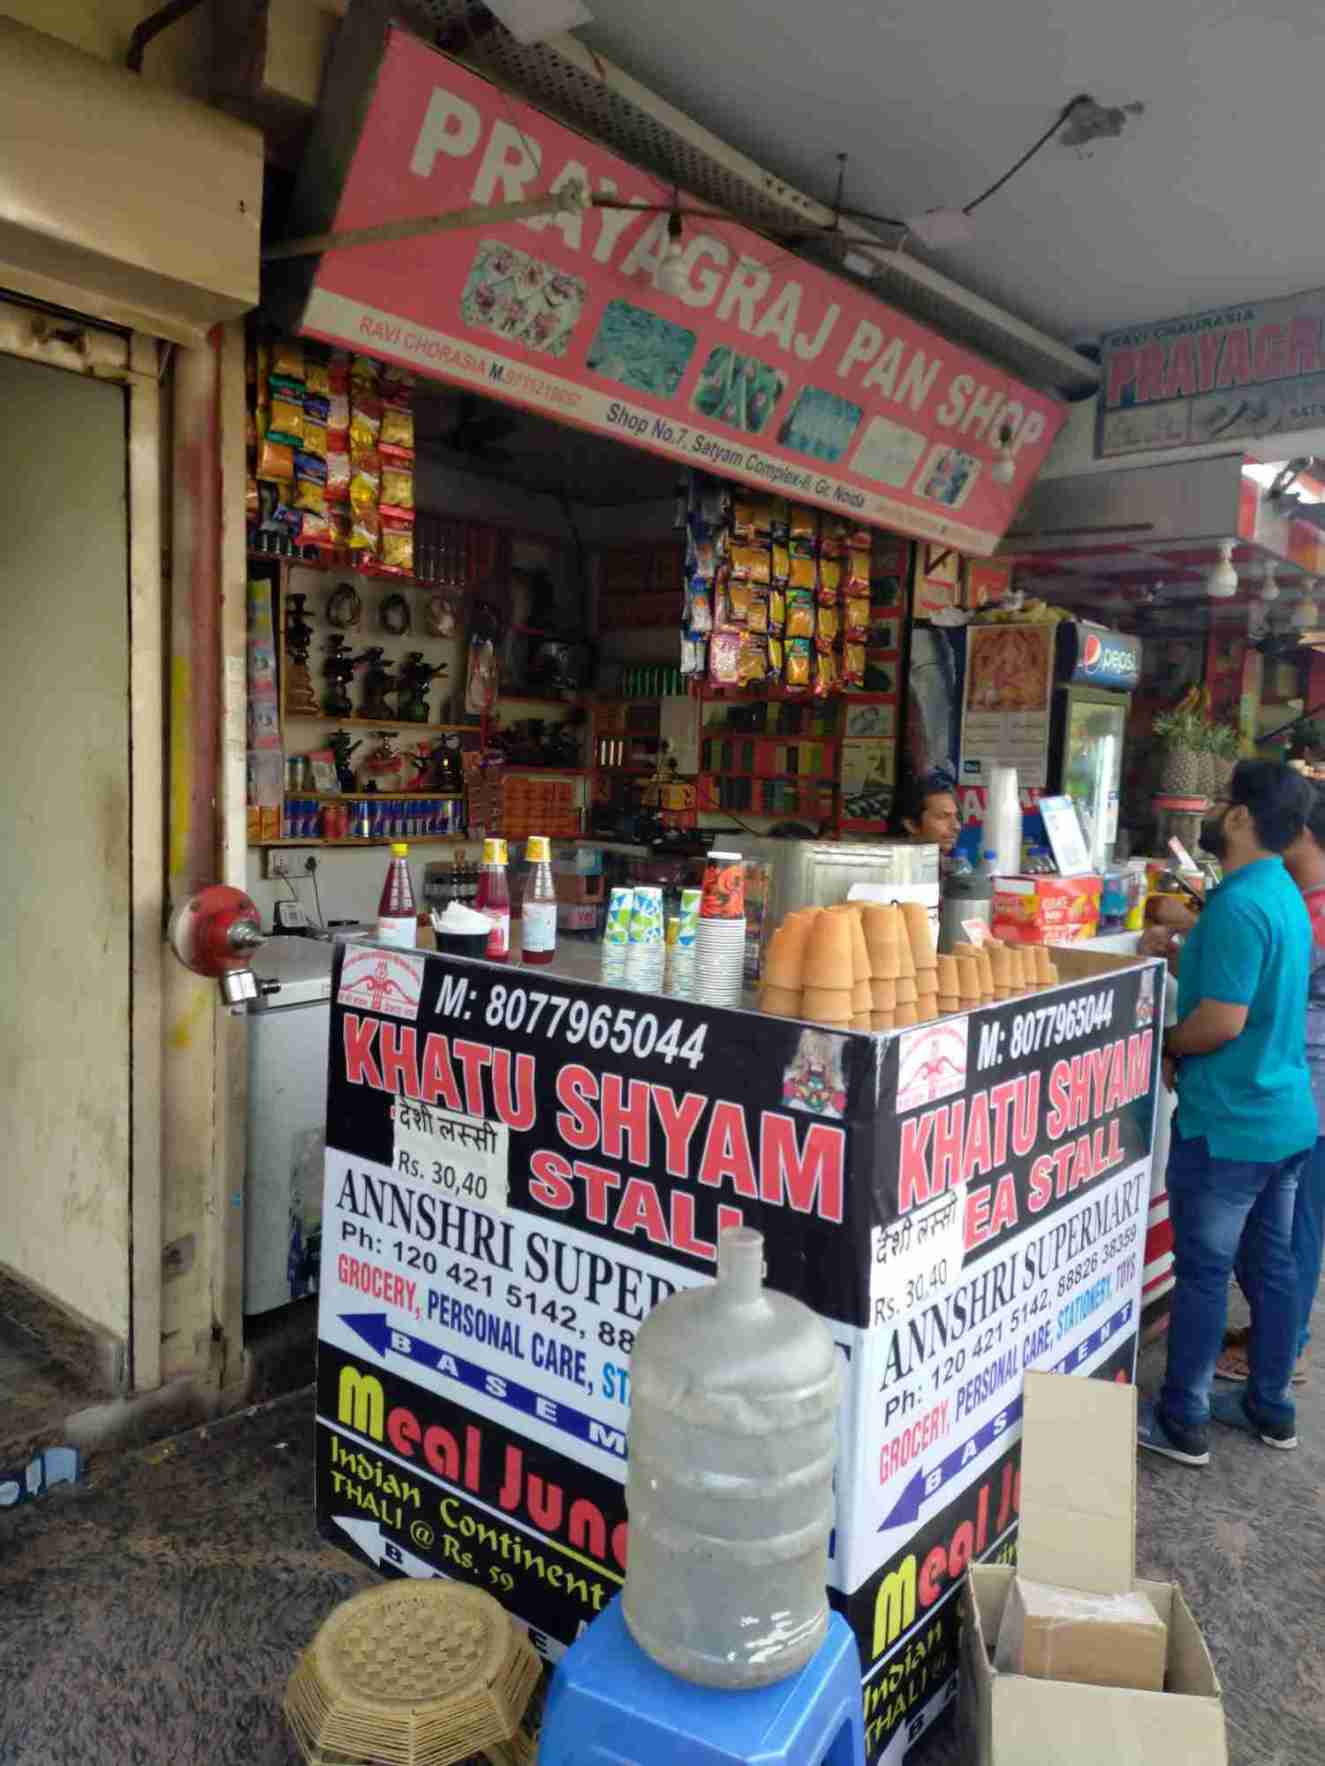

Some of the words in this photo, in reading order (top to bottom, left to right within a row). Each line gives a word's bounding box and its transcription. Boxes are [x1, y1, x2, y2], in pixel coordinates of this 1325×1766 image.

[410, 85, 841, 362] PRAYAGRAJ
[836, 319, 943, 412] PAN
[936, 374, 1046, 459] SHOP
[359, 316, 401, 345] RAVI
[403, 331, 486, 375] CHORASIA
[606, 403, 649, 436] Shop
[691, 434, 743, 465] Satyam
[434, 974, 477, 1021] M:
[485, 984, 708, 1070] 8077965044
[977, 1021, 1005, 1071] M:
[1009, 989, 1115, 1060] 8077965044
[342, 1013, 536, 1131] KHATU
[556, 1063, 847, 1224] SHYAM
[399, 1100, 435, 1135] देशी
[437, 1114, 496, 1155] लस्सी
[898, 1070, 1041, 1216] KHATU
[1046, 1028, 1153, 1140] SHYAM
[1027, 1118, 1126, 1214] STALL
[336, 1168, 515, 1273] ANNSHRI
[397, 1150, 423, 1179] Rs.
[432, 1161, 488, 1201] 30,40
[337, 1254, 422, 1320] GROCERY,
[427, 1290, 524, 1360] PERSONAL
[531, 1332, 594, 1397] CARE,
[341, 1221, 382, 1254] Ph:
[393, 1241, 437, 1275] 120
[446, 1263, 493, 1297] 421
[506, 1285, 586, 1338] 5142,
[875, 1296, 901, 1328] Rs.
[880, 1252, 1017, 1393] ANNSHRI
[1022, 1169, 1147, 1291] SUPERMART
[884, 1382, 923, 1429] Ph:
[930, 1347, 966, 1391] 120
[972, 1321, 1004, 1359] 421
[1009, 1288, 1051, 1334] 5142,
[1056, 1250, 1099, 1299] 88826
[879, 1398, 951, 1487] GROCERY,
[955, 1344, 1021, 1424] PERSONAL
[1022, 1319, 1055, 1369] CARE,
[331, 1436, 421, 1509] Indian
[331, 1470, 402, 1529] THALI
[410, 1520, 435, 1550] @
[442, 1534, 479, 1575] Rs.
[489, 1566, 514, 1591] 59
[864, 1619, 942, 1721] Indian
